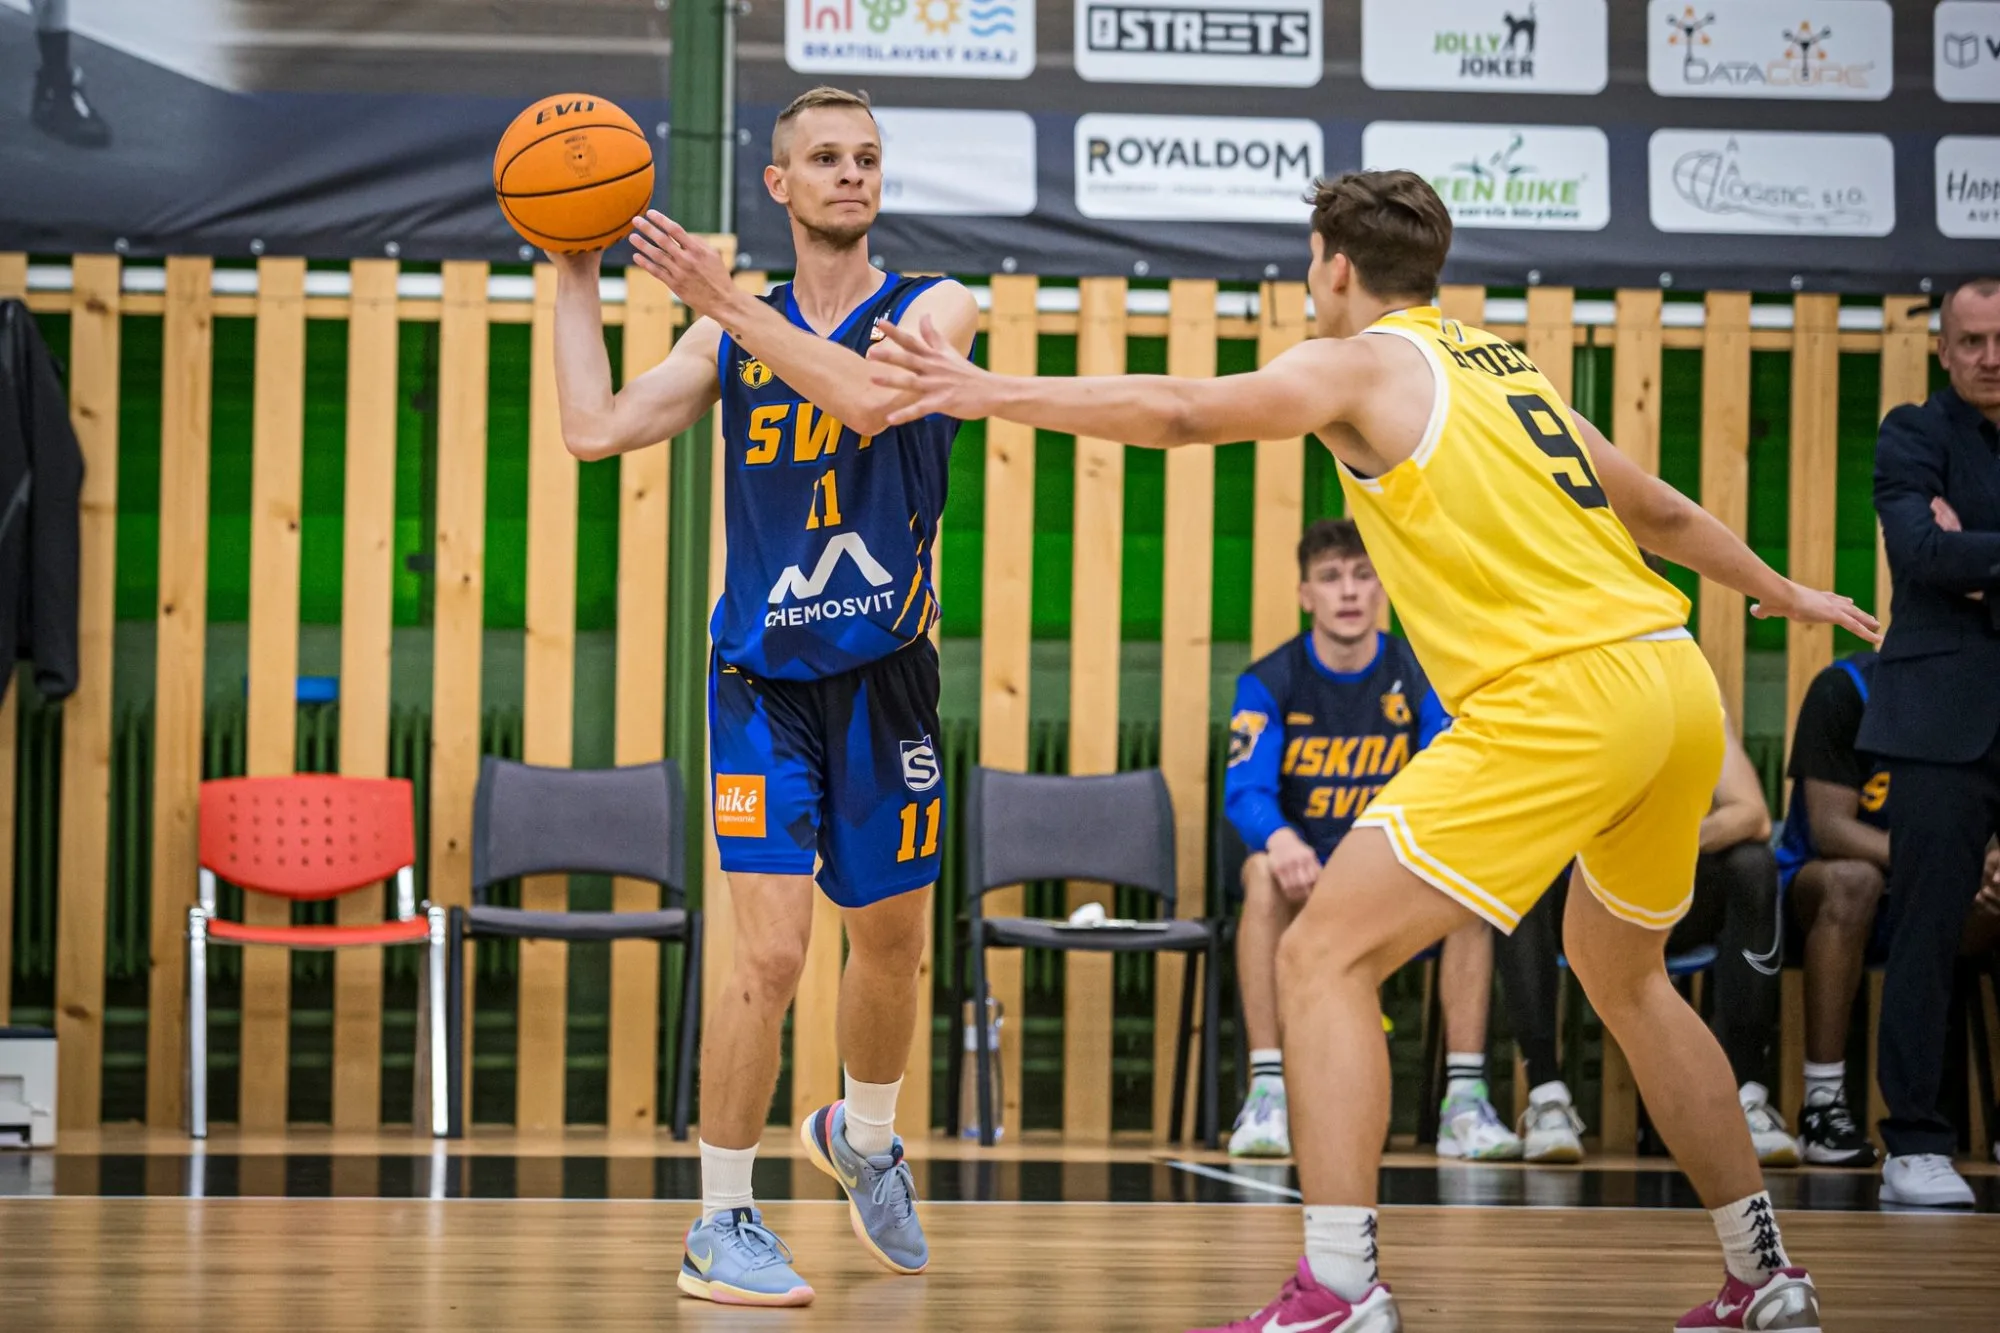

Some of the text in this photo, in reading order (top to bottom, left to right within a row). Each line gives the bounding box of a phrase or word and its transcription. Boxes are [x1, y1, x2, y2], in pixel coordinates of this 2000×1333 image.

[962, 48, 1017, 63] KRAJ
[1434, 33, 1500, 53] JOLLY
[1460, 57, 1534, 78] JOKER
[536, 101, 595, 126] EVO
[1088, 138, 1311, 178] ROYALDOM
[1504, 178, 1578, 204] BIKE
[745, 402, 873, 465] SVI
[1506, 394, 1609, 509] 9
[764, 590, 895, 628] CHEMOSVIT
[718, 786, 757, 813] niké
[1303, 784, 1386, 818] SVI
[896, 797, 941, 863] 11
